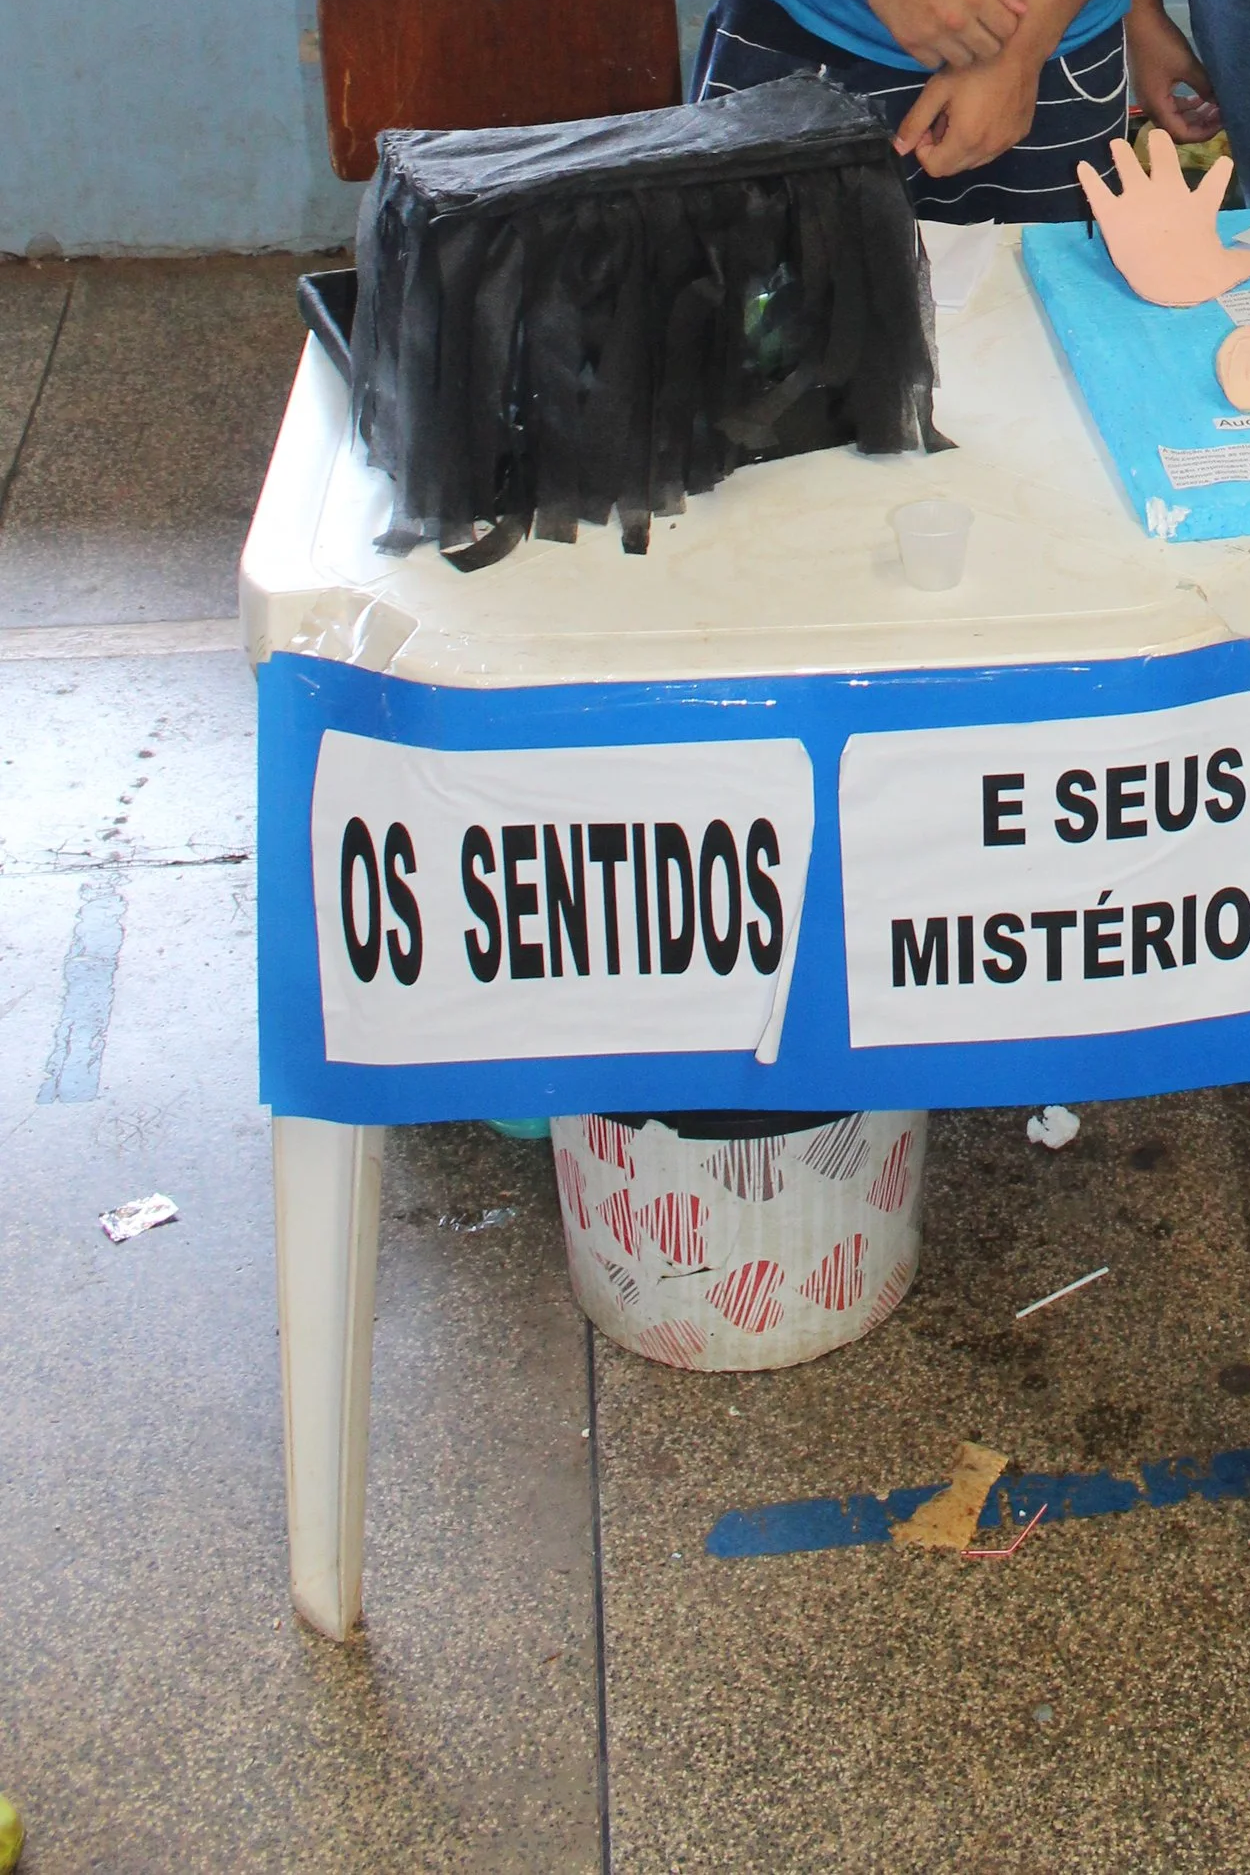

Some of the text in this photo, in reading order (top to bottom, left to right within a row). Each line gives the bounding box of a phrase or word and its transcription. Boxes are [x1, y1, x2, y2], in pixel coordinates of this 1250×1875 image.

[983, 747, 1246, 847] E SEUS
[341, 816, 783, 986] OS SENTIDOS
